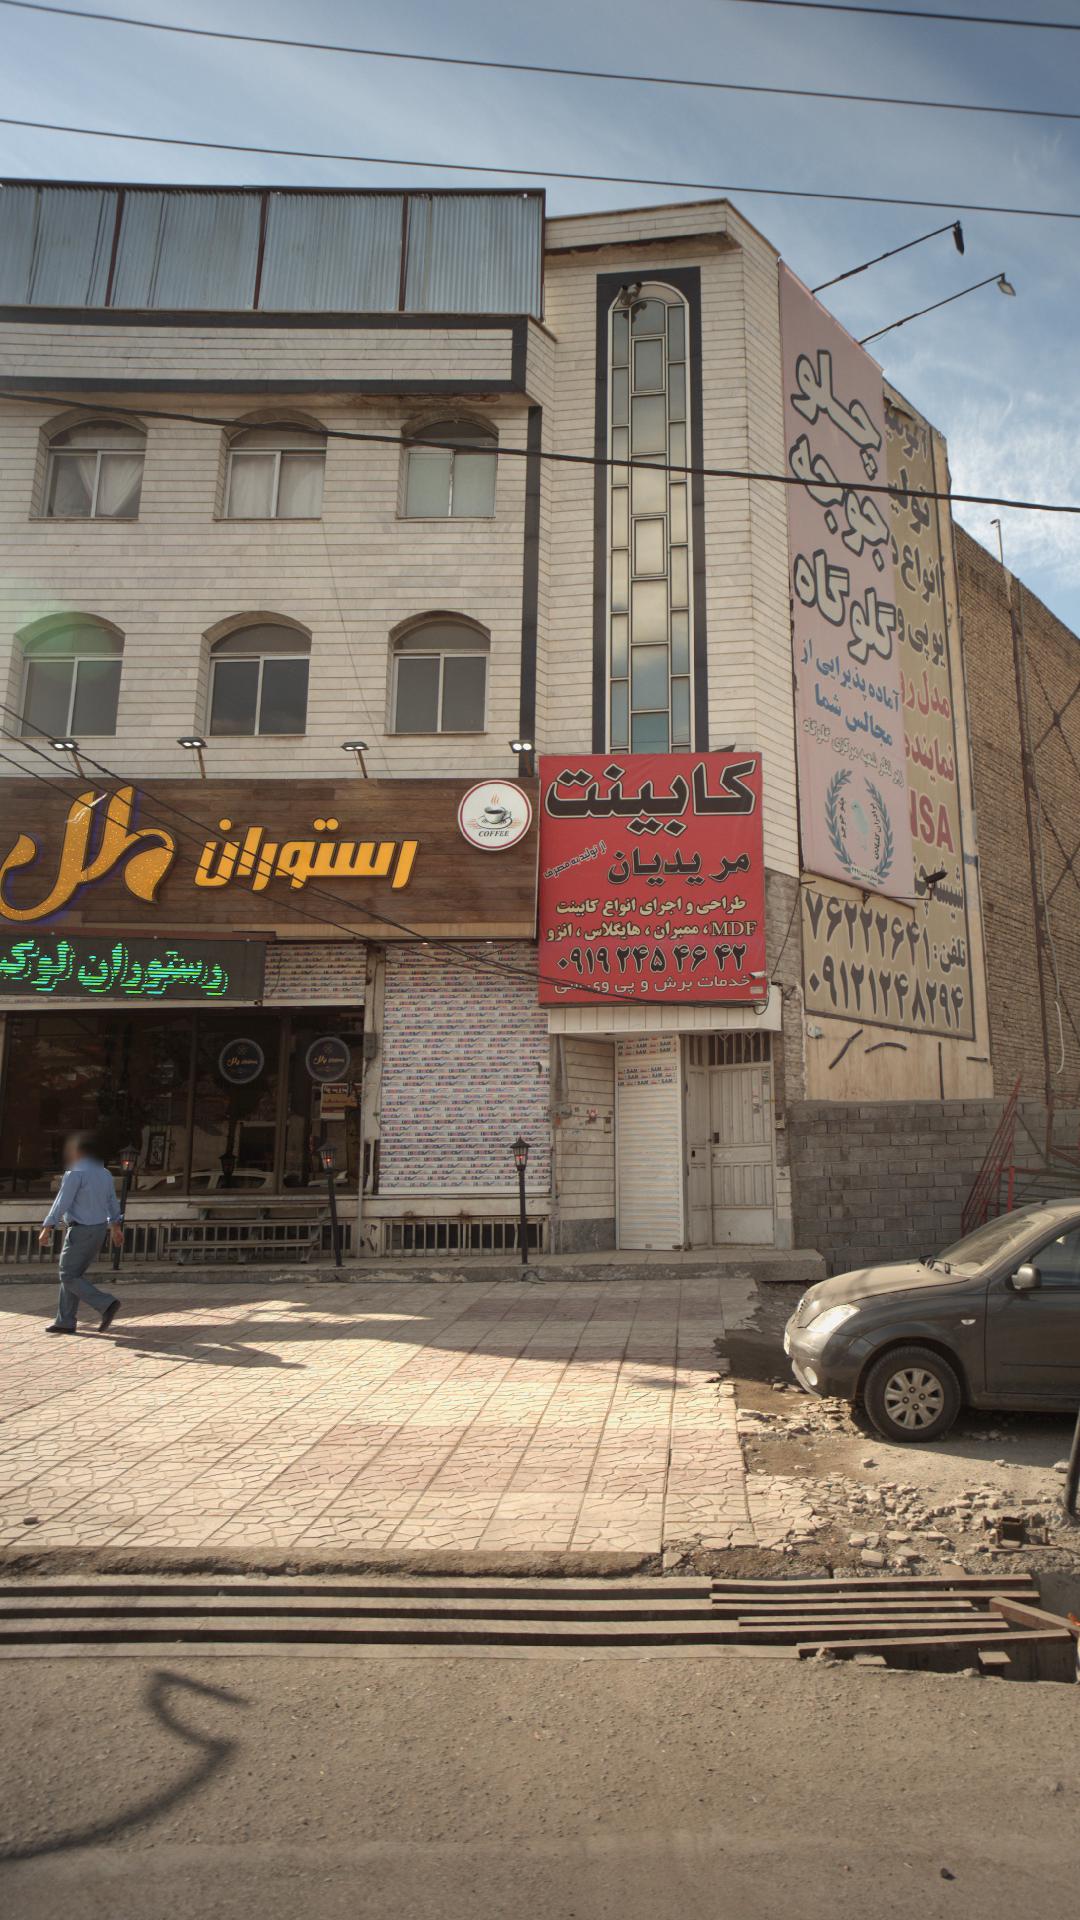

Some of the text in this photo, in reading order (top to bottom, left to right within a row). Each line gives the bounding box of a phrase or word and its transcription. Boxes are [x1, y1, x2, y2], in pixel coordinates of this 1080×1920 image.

[790, 349, 882, 481] چلو
[788, 434, 890, 573] جوجه
[901, 544, 942, 603] انواع
[793, 549, 898, 665] گلوگاه
[801, 638, 900, 712] آماده پذیرایی از
[917, 670, 950, 719] مدل
[815, 683, 893, 747] مجالس شما
[545, 758, 757, 837] کابینت
[194, 817, 420, 892] رستوران
[478, 830, 510, 838] COFFEE
[546, 922, 574, 942] انزو
[556, 896, 746, 917] طراحی و اجرای انواع کابینت
[78, 942, 228, 996] رستوران
[614, 981, 635, 995] پی
[640, 980, 649, 992] و
[654, 978, 693, 993] برش
[697, 974, 750, 988] خدمات
